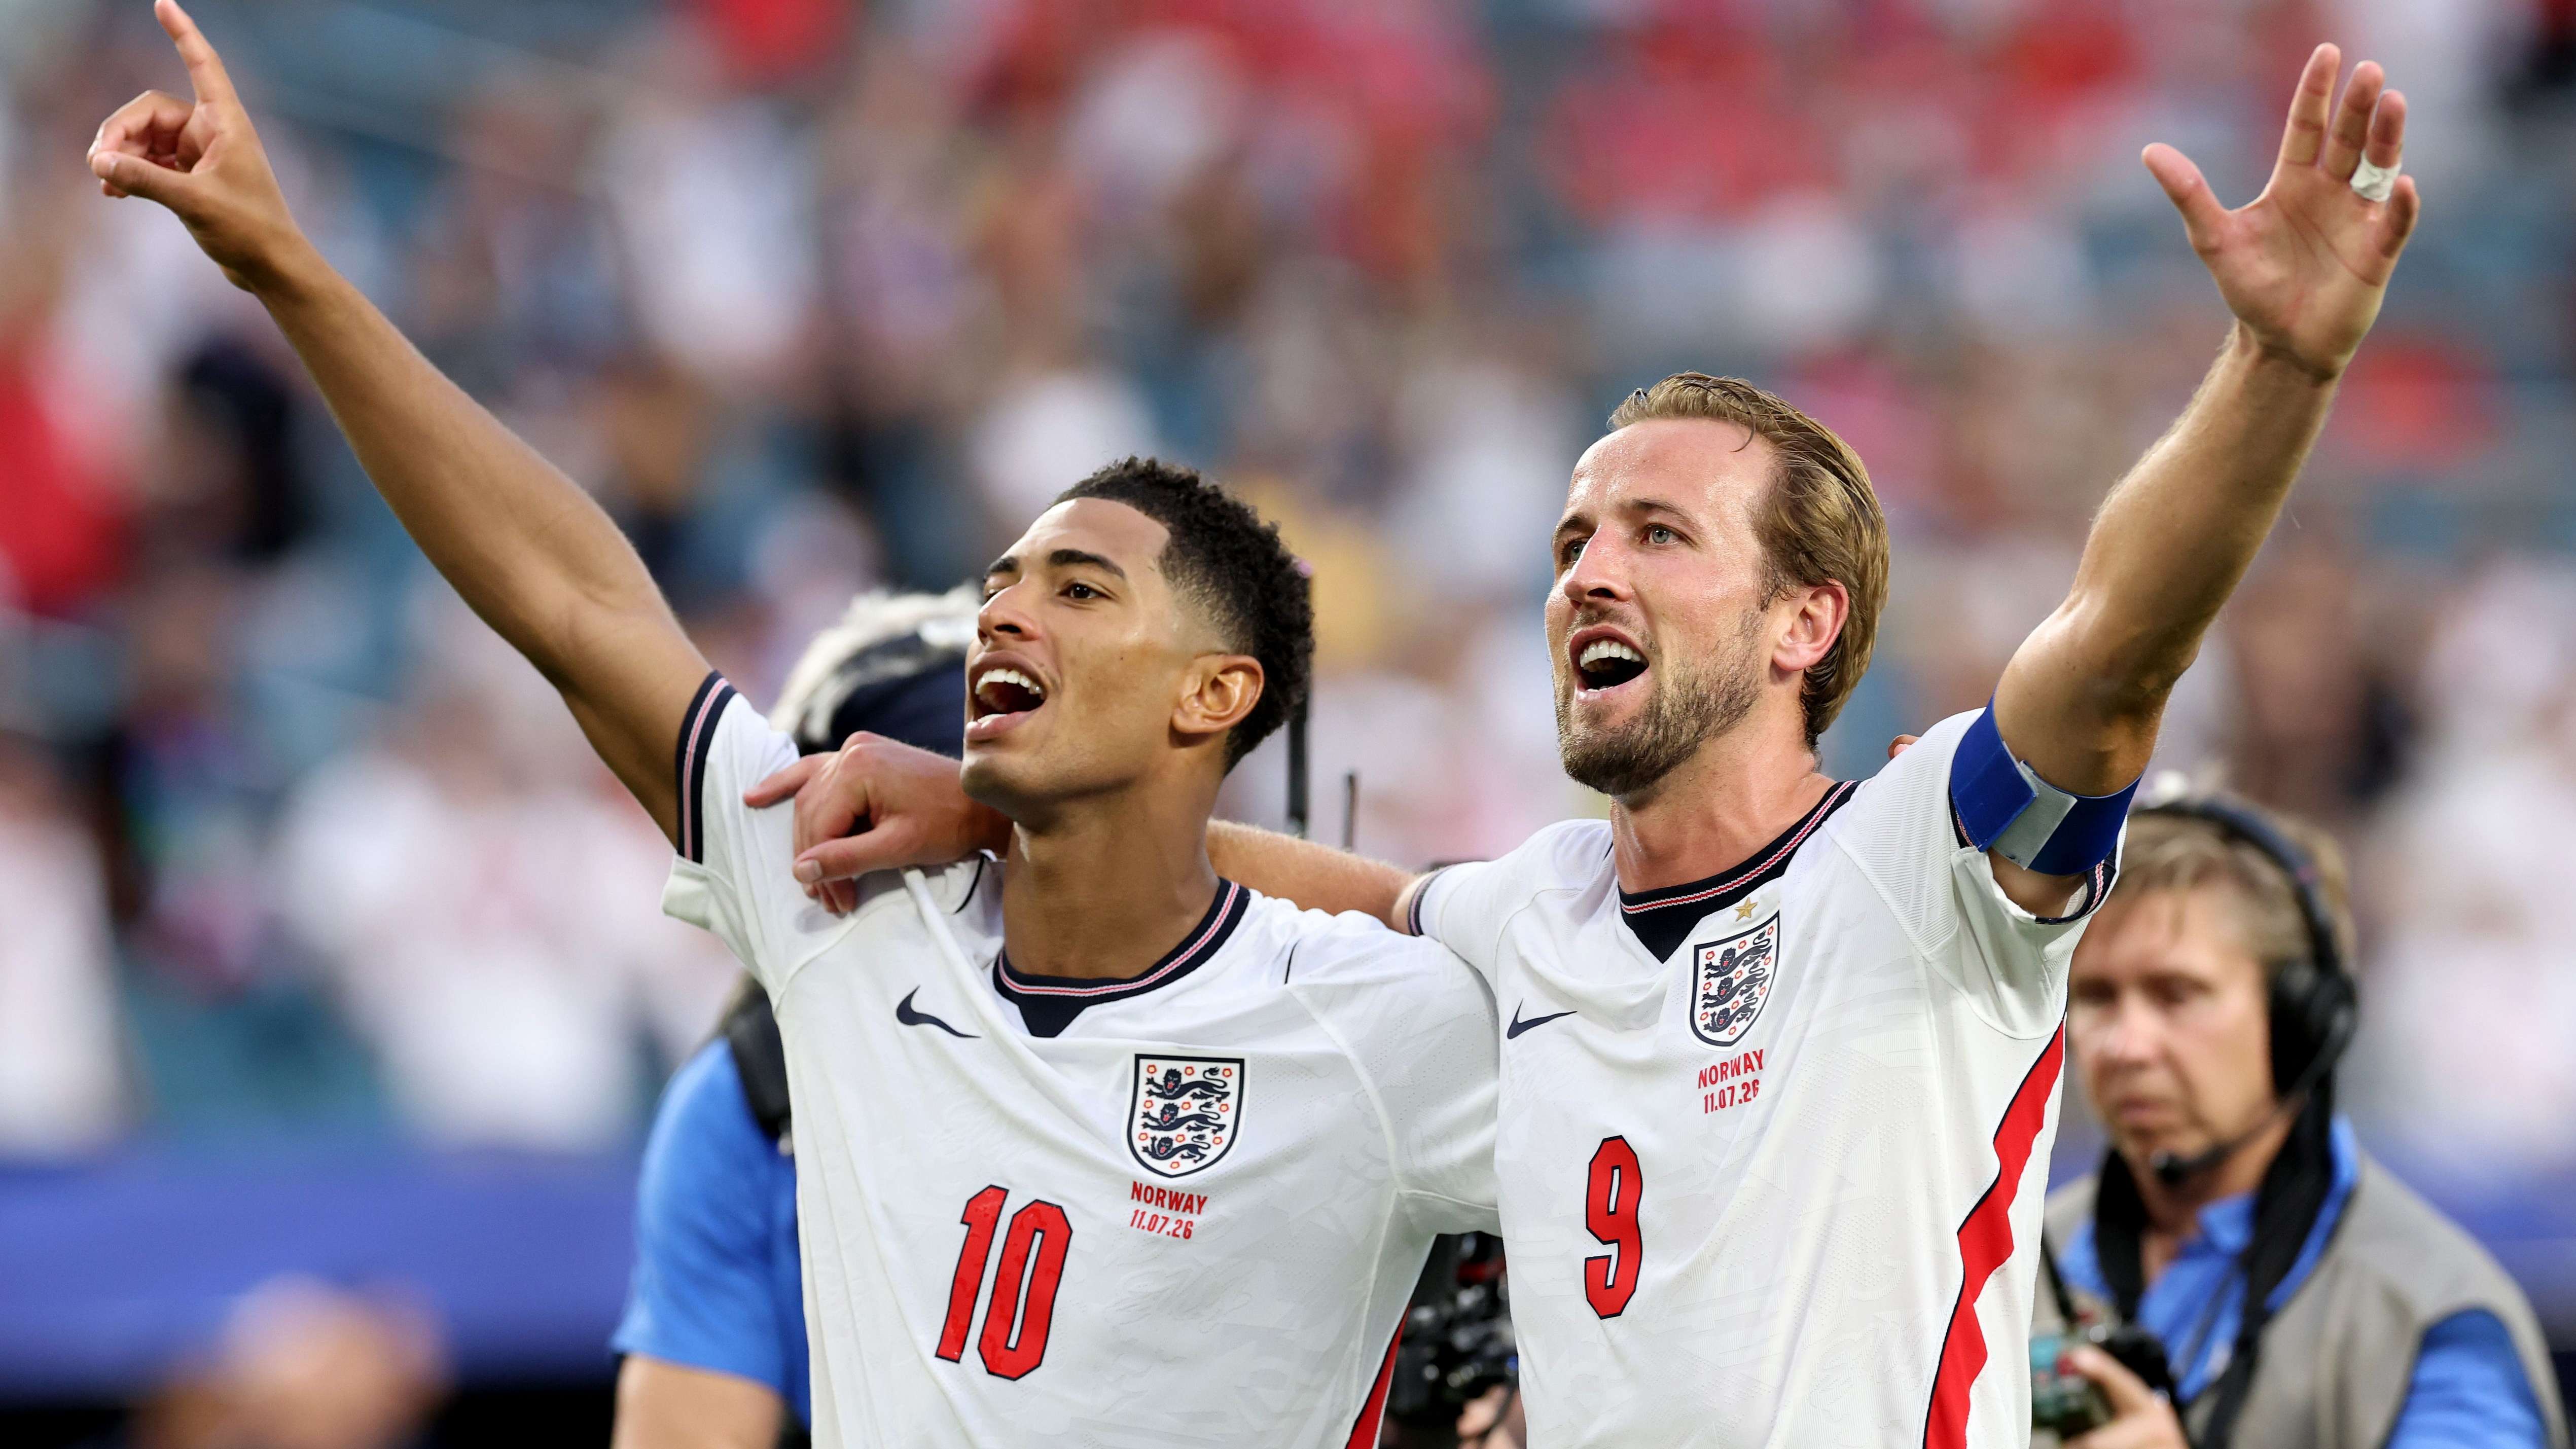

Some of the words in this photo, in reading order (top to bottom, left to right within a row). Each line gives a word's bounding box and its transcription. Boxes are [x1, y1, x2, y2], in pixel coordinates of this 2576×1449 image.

[1698, 1049, 1764, 1089] NORWAY
[1704, 1079, 1760, 1114] 11.07.26
[1130, 1180, 1208, 1215] NORWAY
[1130, 1209, 1194, 1240] 11.07.26
[1585, 1135, 1643, 1320] 9
[935, 1184, 1073, 1381] 10
